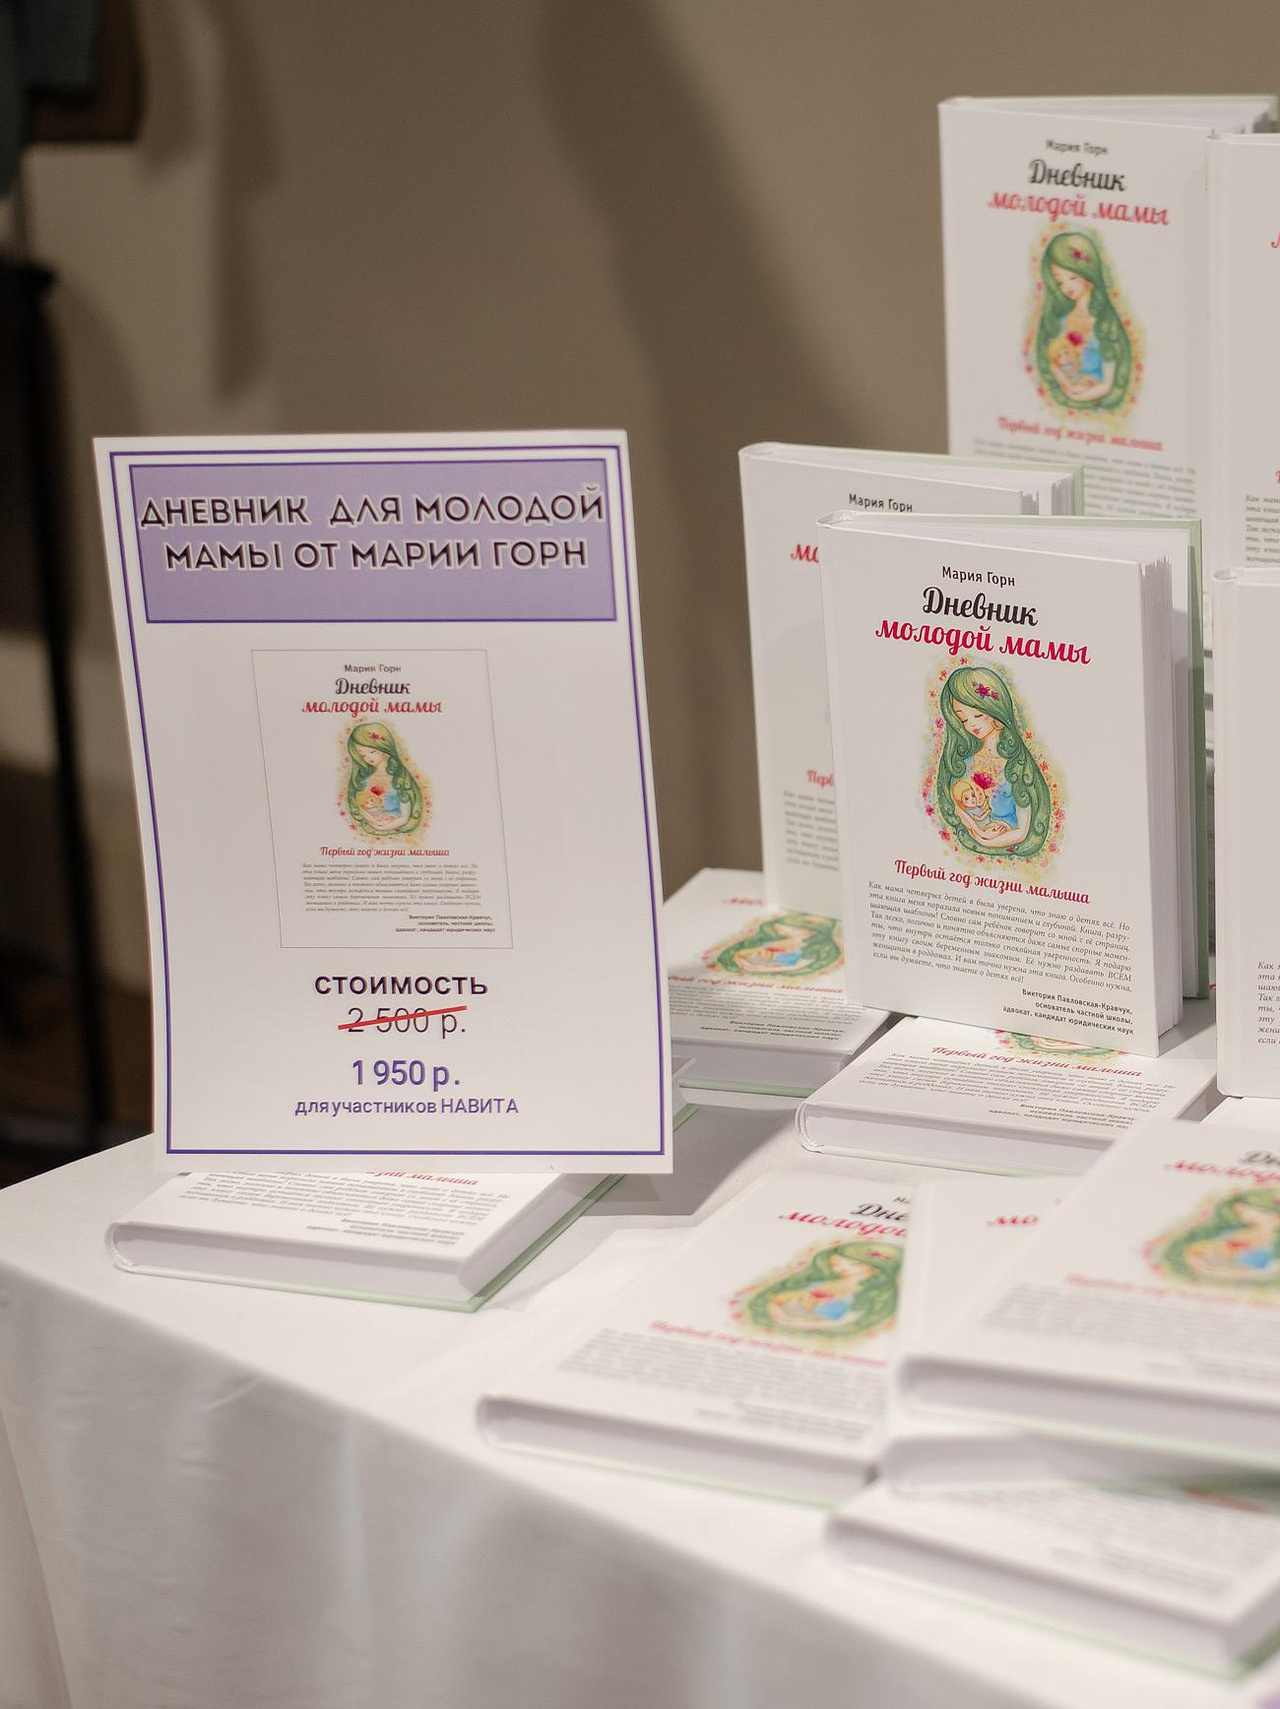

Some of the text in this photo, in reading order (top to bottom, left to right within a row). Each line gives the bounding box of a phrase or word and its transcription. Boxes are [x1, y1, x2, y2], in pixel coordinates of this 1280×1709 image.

[1029, 159, 1124, 191] Дневник
[141, 483, 605, 528] ДНЕВНИК ДЛЯ МОЛОДОЙ
[849, 493, 912, 512] Мария Горн
[165, 538, 588, 571] МАМЫ ОТ МАРИИ ГОРН
[942, 566, 1014, 588] Мария Горн
[922, 586, 1039, 626] Дневник
[875, 620, 1090, 664] молодой мамы
[344, 664, 400, 673] Мария Горн
[335, 678, 410, 694] Дневник
[302, 698, 441, 717] молодой мамы
[320, 846, 354, 857] Первый
[357, 847, 372, 858] год
[894, 859, 1090, 904] Первый год жизни малыша
[1258, 961, 1274, 969] Как
[315, 976, 487, 994] СТОИМОСТЬ
[1022, 988, 1132, 1014] Виктория Павловская-Кравчук,
[1034, 1002, 1132, 1024] основатель частной школы,
[376, 1008, 430, 1033] 500
[441, 1013, 466, 1039] р.
[1003, 1006, 1133, 1035] адвокат, кандидат юридических наук
[931, 1046, 1143, 1077] Первый год жизни малыша
[352, 1060, 459, 1091] 1 950 р.
[295, 1098, 518, 1116] для участников НАВИТА
[778, 1212, 907, 1236] молодо
